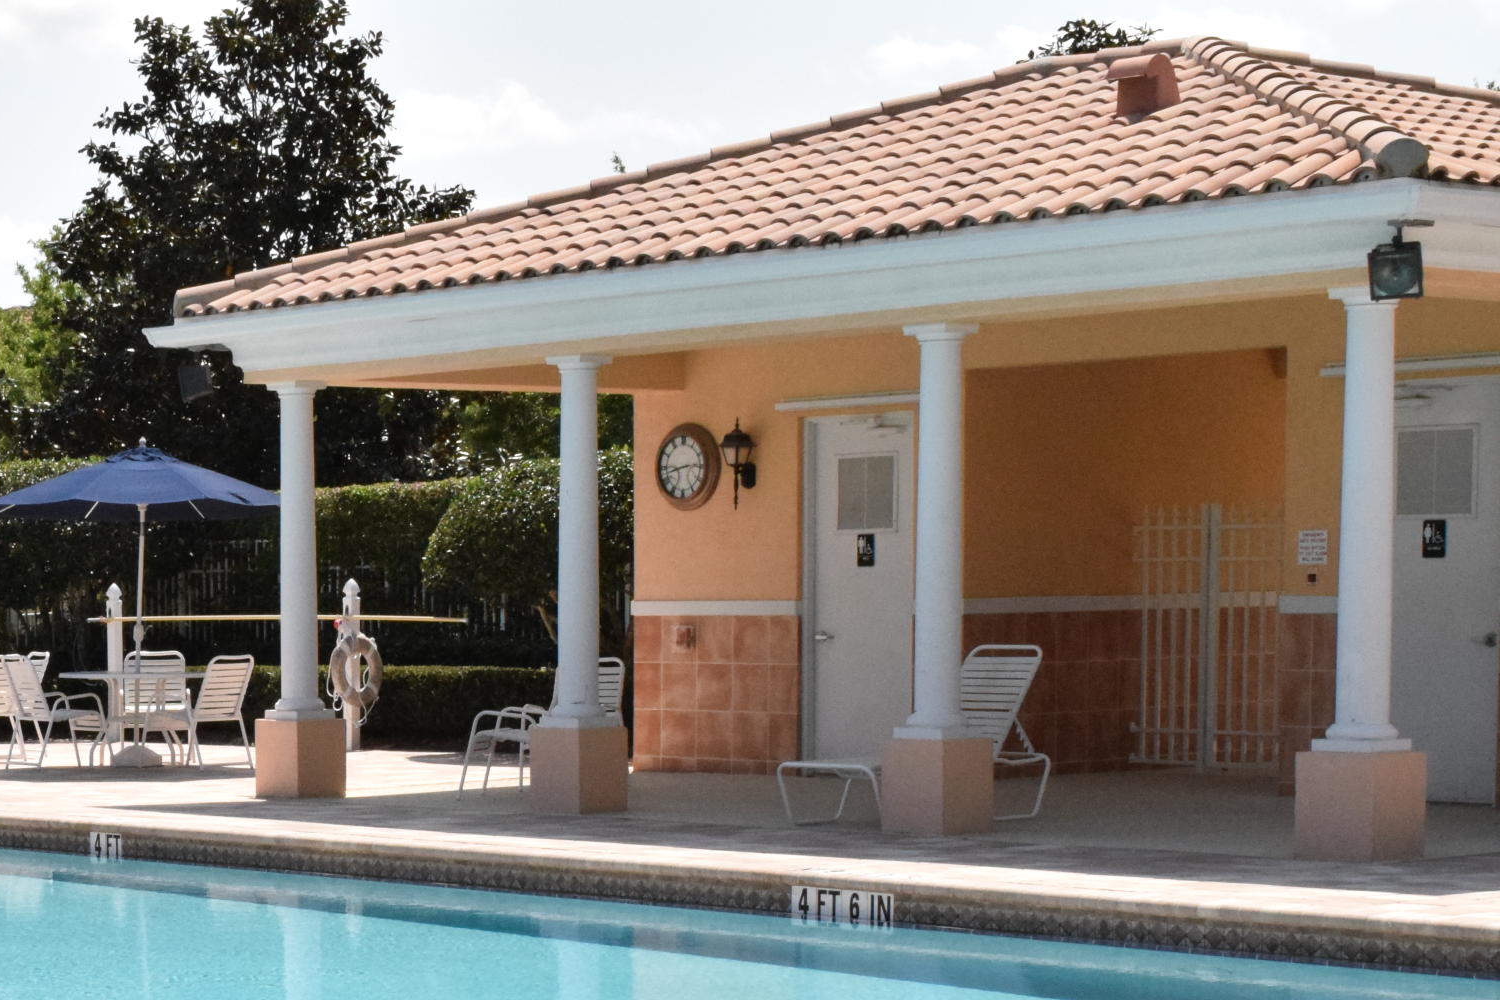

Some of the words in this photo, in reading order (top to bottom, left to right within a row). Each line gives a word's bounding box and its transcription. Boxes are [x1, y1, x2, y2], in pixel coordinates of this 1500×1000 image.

[95, 833, 102, 858] 4
[106, 834, 121, 859] FT
[798, 888, 809, 920] 4
[817, 889, 840, 922] FT
[849, 893, 860, 924] 6
[870, 894, 891, 927] IN
